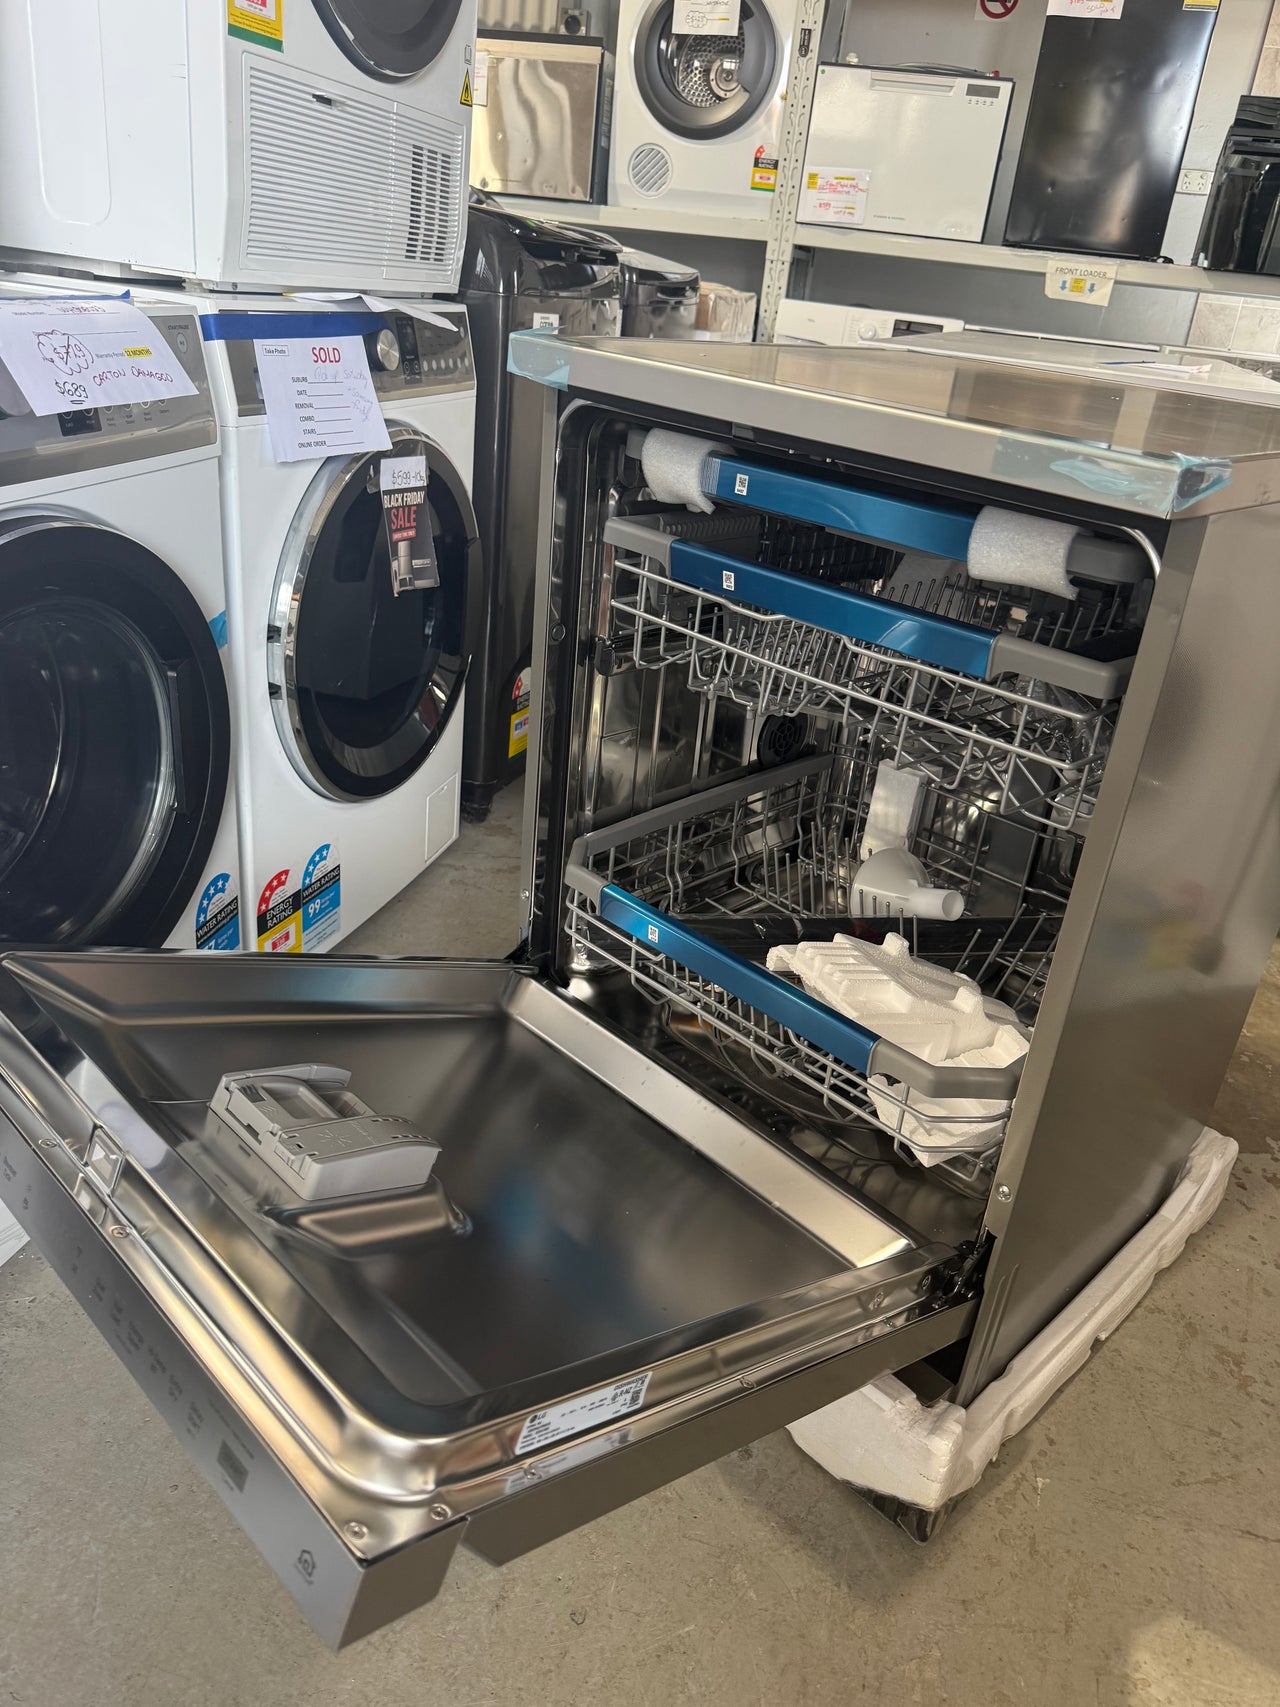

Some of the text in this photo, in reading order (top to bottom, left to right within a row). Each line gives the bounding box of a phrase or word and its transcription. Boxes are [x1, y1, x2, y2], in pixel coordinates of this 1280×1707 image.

[1055, 267, 1079, 276] FRONT
[131, 348, 153, 357] MONTHS
[311, 346, 341, 364] SOLD
[93, 368, 126, 386] CARTON
[54, 378, 89, 399] $689
[295, 402, 315, 410] REMOVAL
[298, 441, 313, 449] ONLINE
[383, 490, 425, 508] BLACK FRIDAY
[391, 506, 417, 530] SALE
[302, 882, 321, 898] WATER
[320, 867, 340, 887] RATING
[266, 896, 294, 920] ENERGY
[308, 898, 321, 918] 99
[197, 918, 217, 938] WATER
[216, 899, 238, 922] RATING
[267, 906, 293, 929] RATING
[537, 1411, 547, 1420] LG
